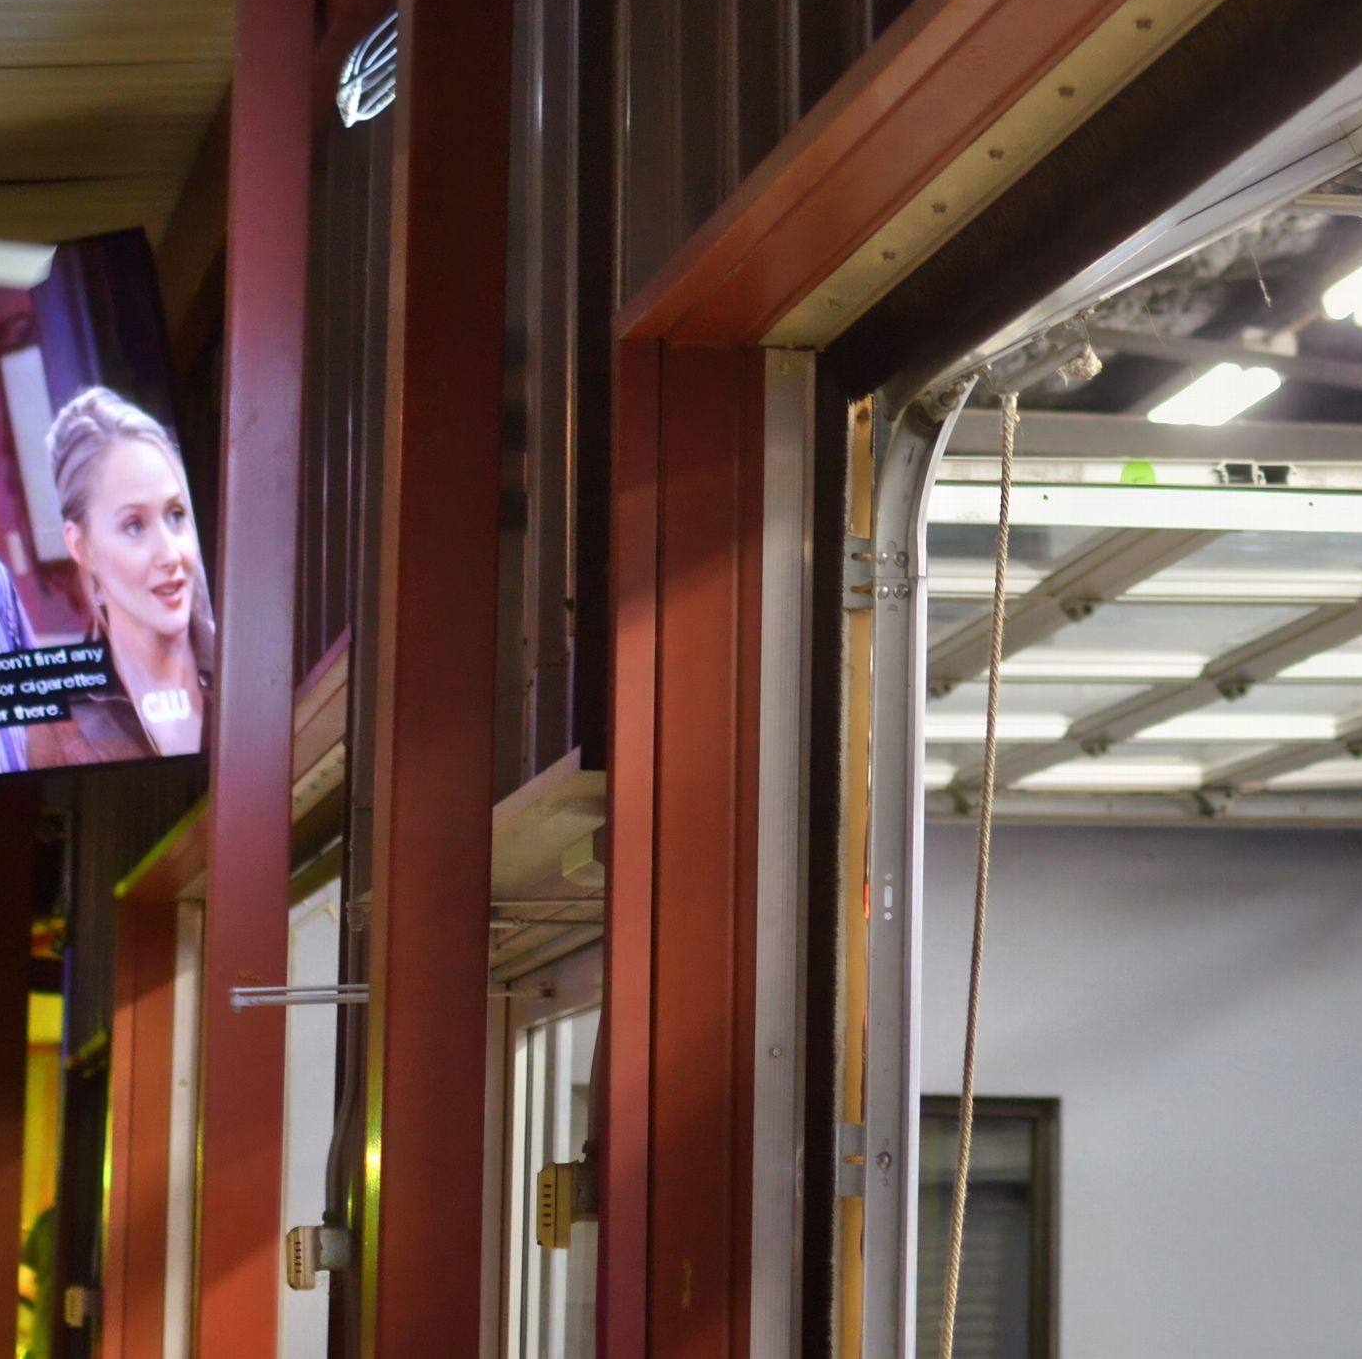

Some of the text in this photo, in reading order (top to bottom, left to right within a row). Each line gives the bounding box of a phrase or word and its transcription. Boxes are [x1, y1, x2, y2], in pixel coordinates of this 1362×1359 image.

[34, 648, 67, 668] find
[70, 645, 105, 663] any
[19, 671, 108, 695] cigarettes
